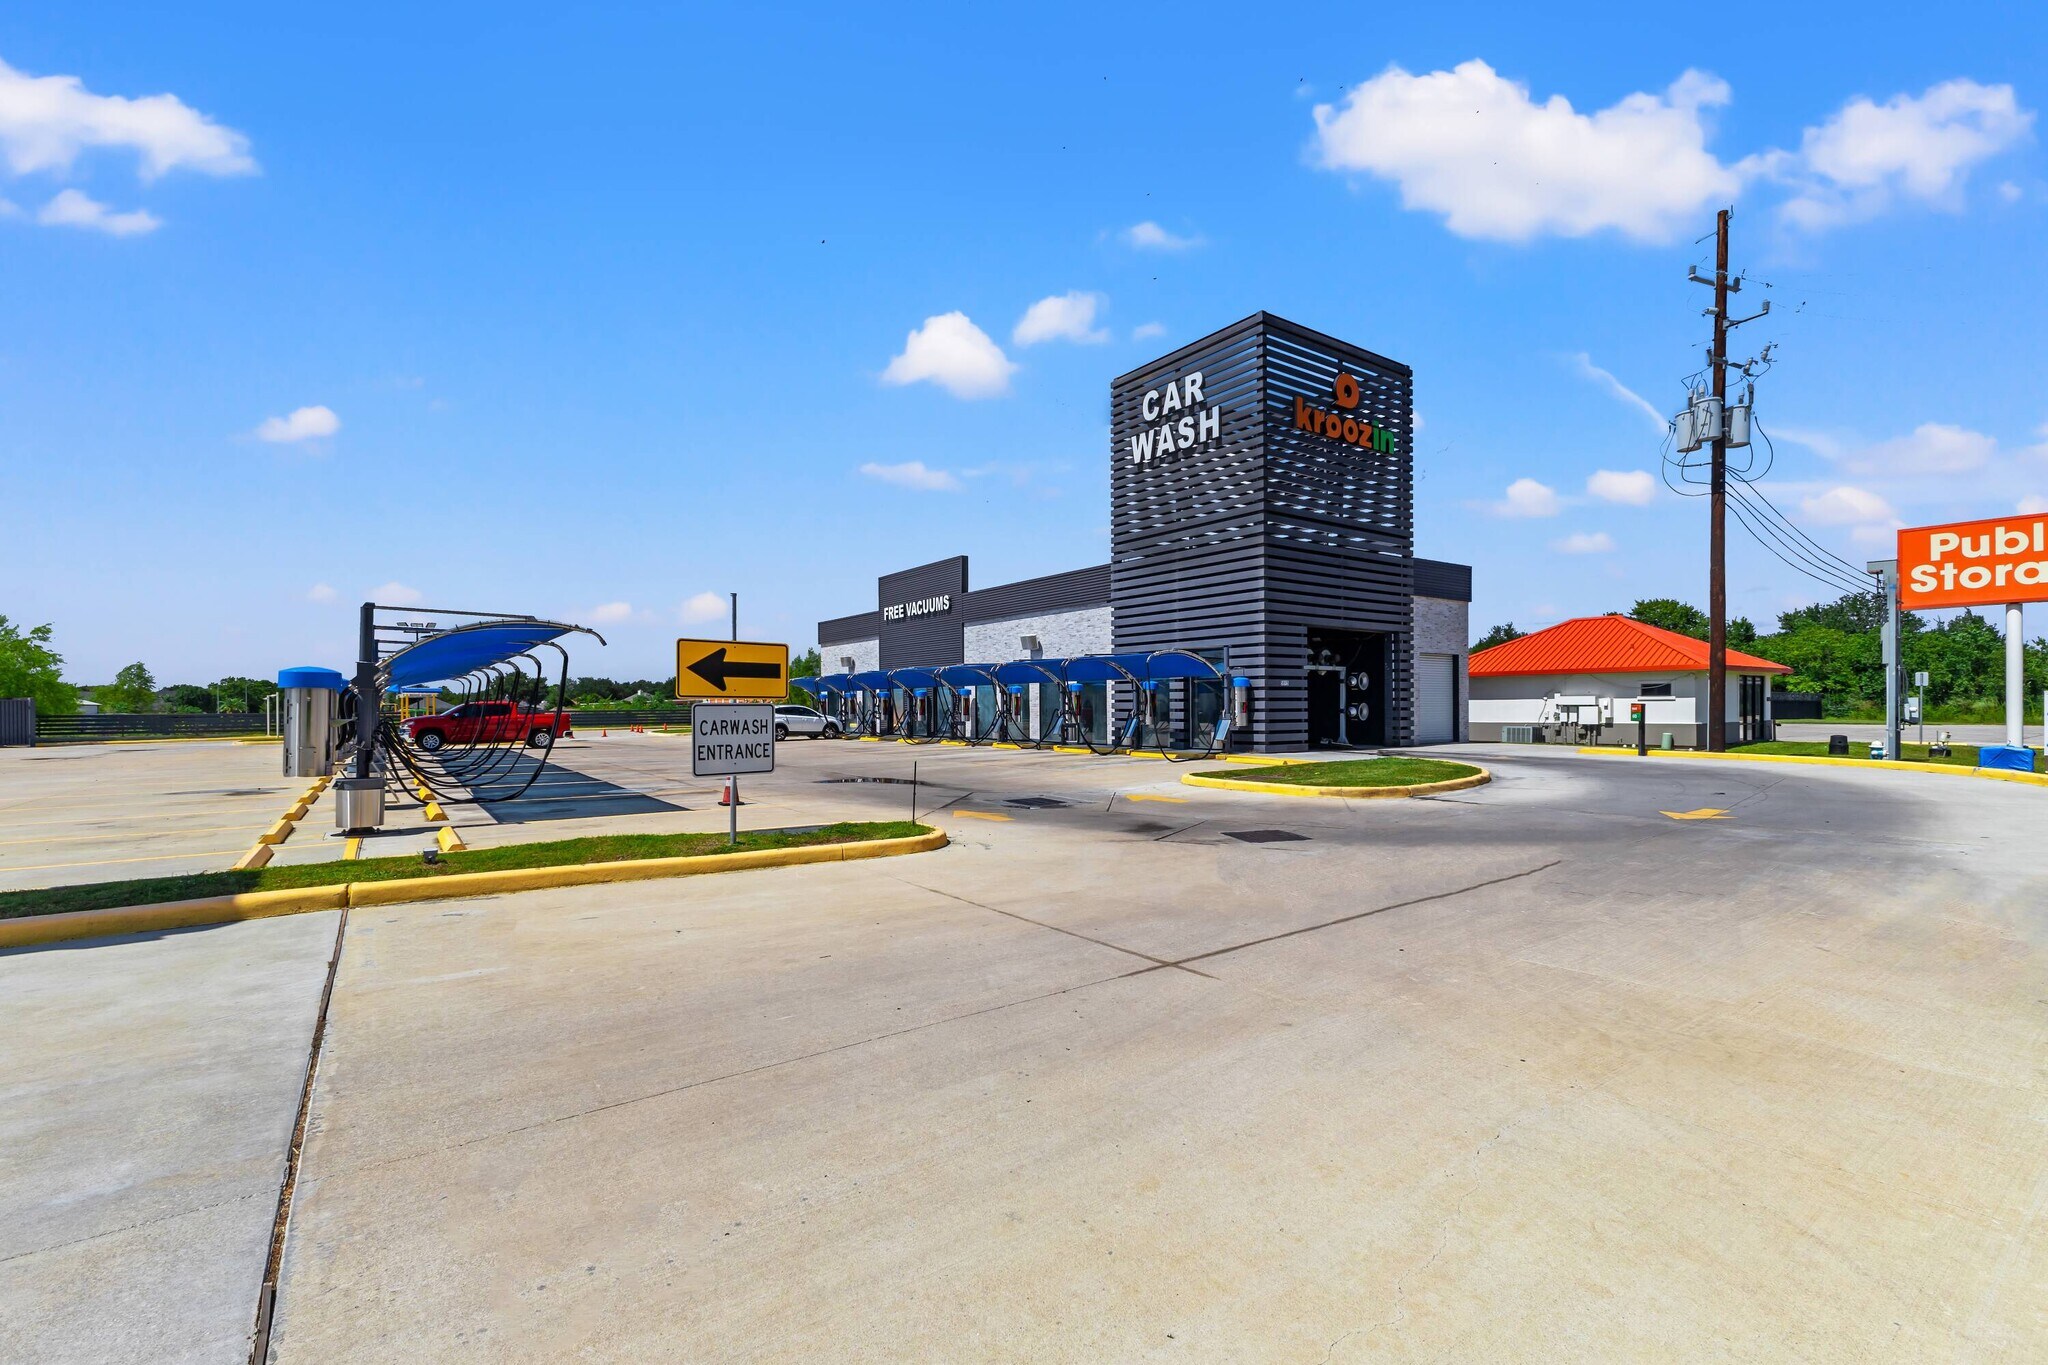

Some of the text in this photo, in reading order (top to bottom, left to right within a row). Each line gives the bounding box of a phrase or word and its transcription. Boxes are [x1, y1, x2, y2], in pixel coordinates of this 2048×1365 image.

[1142, 371, 1204, 421] CAR
[1131, 405, 1220, 464] WASH
[1295, 396, 1395, 455] kroozin
[1930, 522, 2044, 562] Publ
[1910, 560, 2048, 593] Stora
[883, 594, 951, 621] FREE VACUUMS
[700, 719, 768, 736] CARWASH
[697, 743, 770, 761] ENTRANCE
